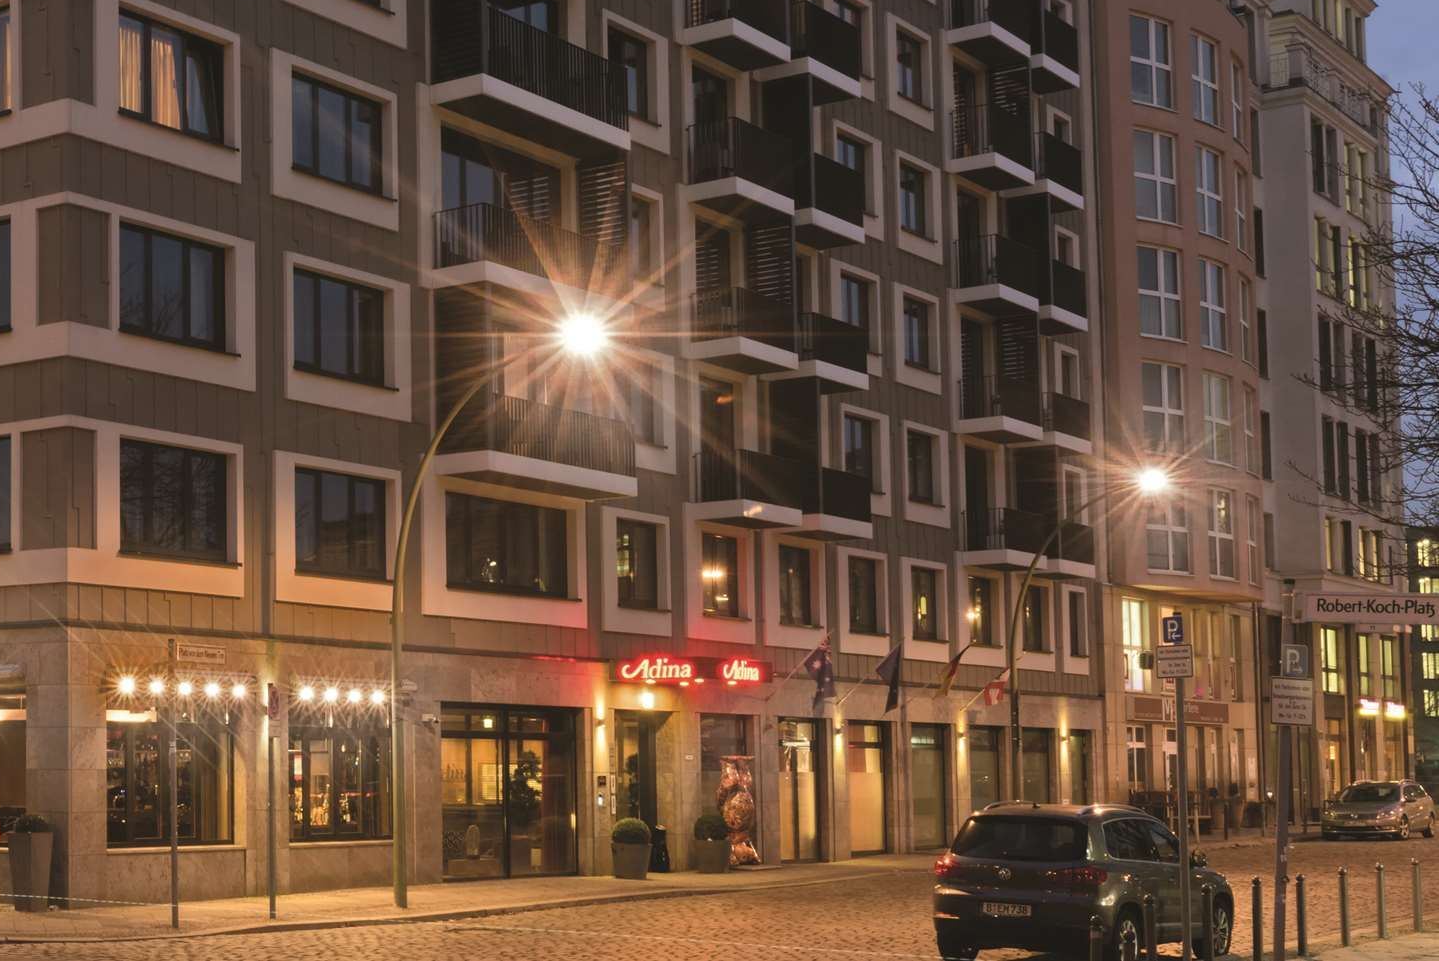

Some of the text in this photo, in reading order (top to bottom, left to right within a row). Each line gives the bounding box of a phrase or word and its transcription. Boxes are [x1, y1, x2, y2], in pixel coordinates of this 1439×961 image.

[1167, 620, 1178, 639] P
[621, 658, 692, 679] Adina
[723, 660, 759, 681] Adina
[1286, 649, 1300, 673] P
